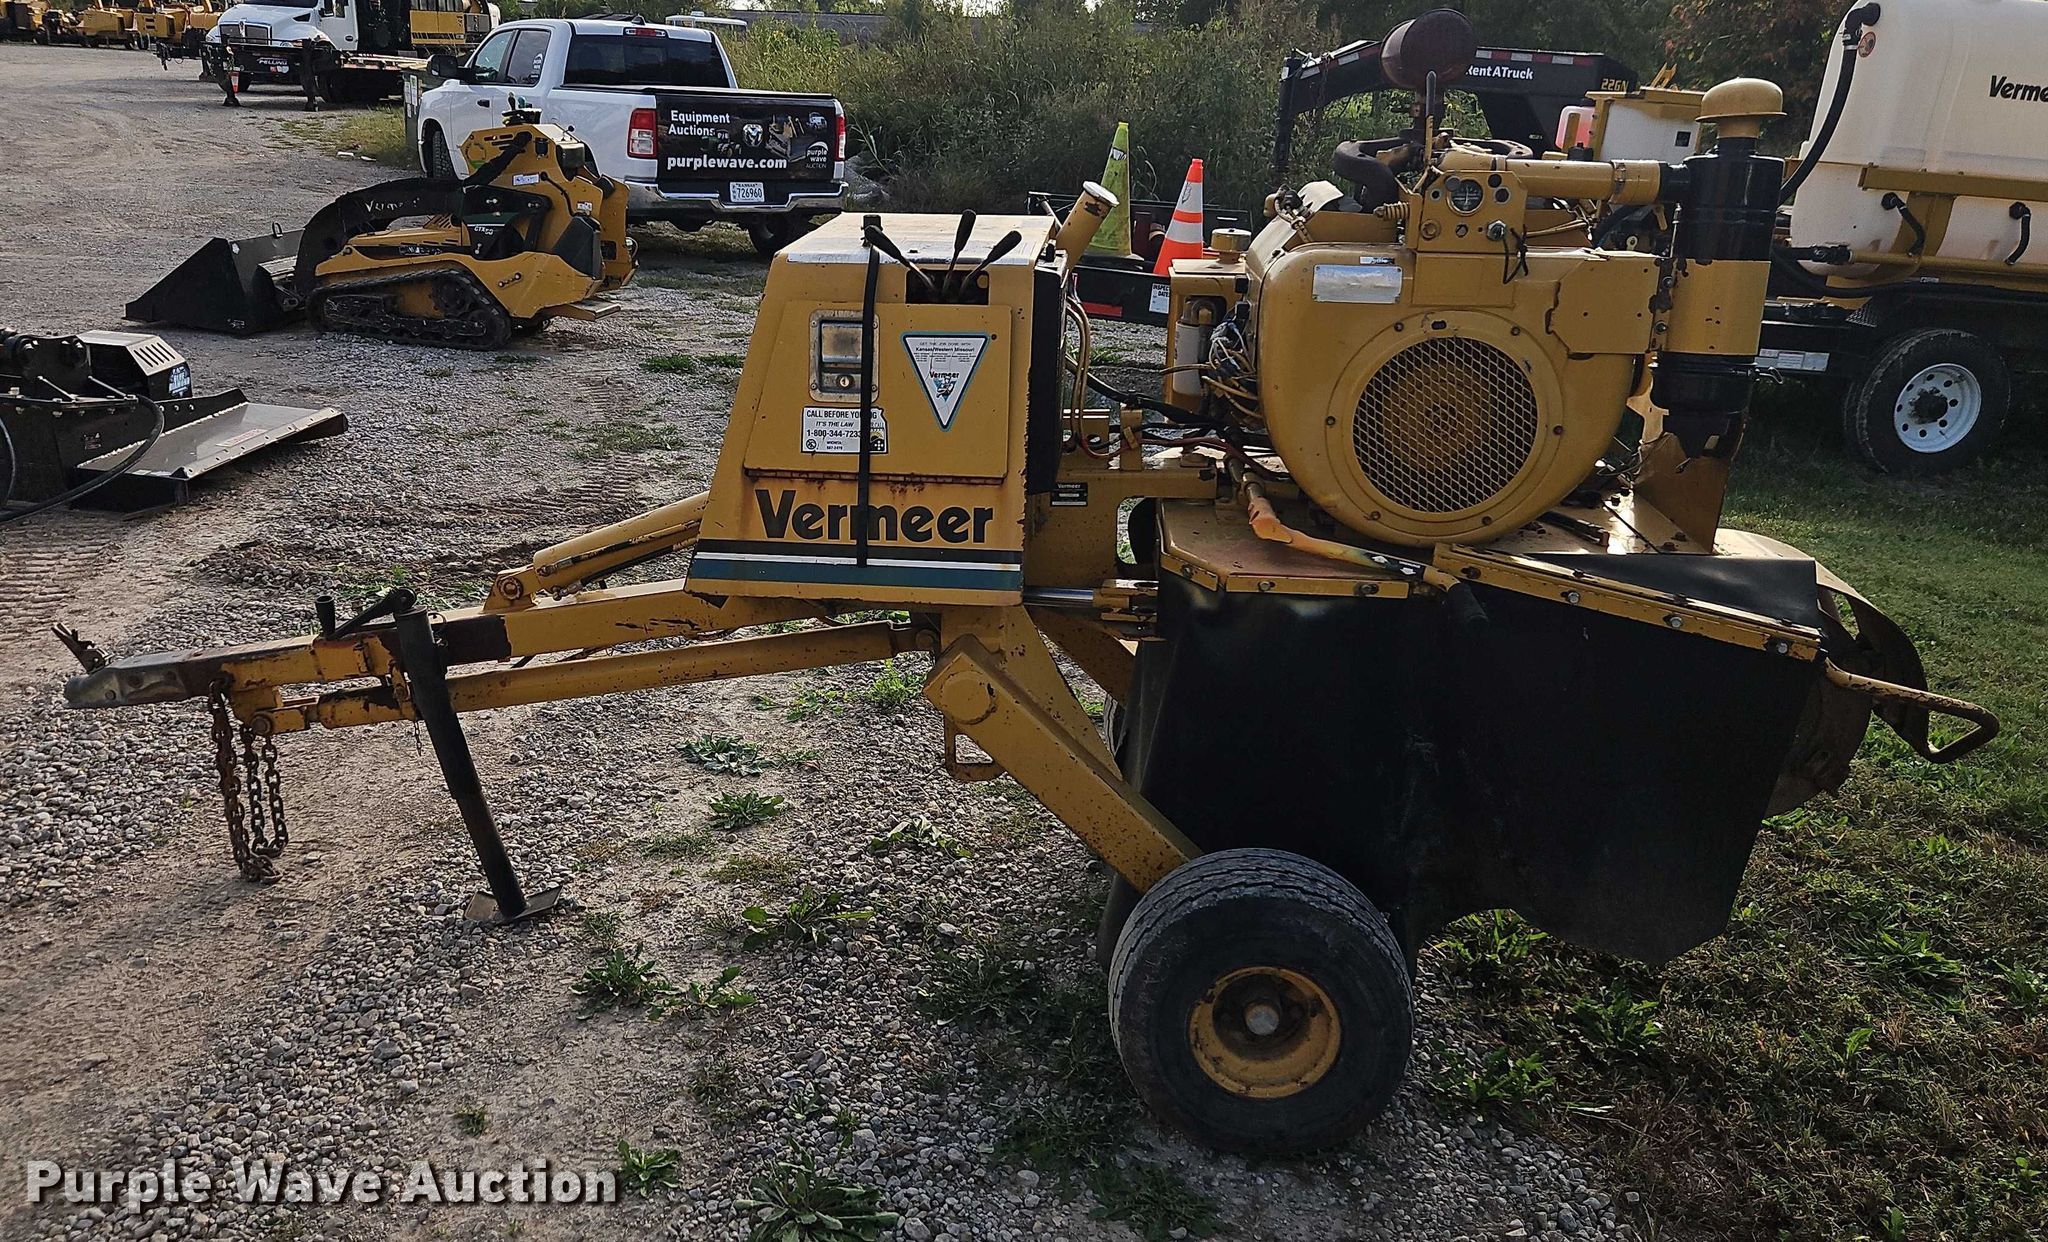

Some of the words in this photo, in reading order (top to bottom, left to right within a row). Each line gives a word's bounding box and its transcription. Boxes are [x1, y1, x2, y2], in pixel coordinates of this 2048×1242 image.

[671, 109, 730, 125] Equipment
[668, 123, 716, 136] Auctions
[806, 147, 828, 157] purple
[667, 154, 787, 170] purplewave.com
[736, 187, 763, 199] 726960
[930, 371, 960, 379] Vermeer
[806, 410, 823, 418] CALL
[824, 410, 849, 418] BEFORE
[850, 411, 860, 419] YO
[755, 489, 994, 543] Vermeer
